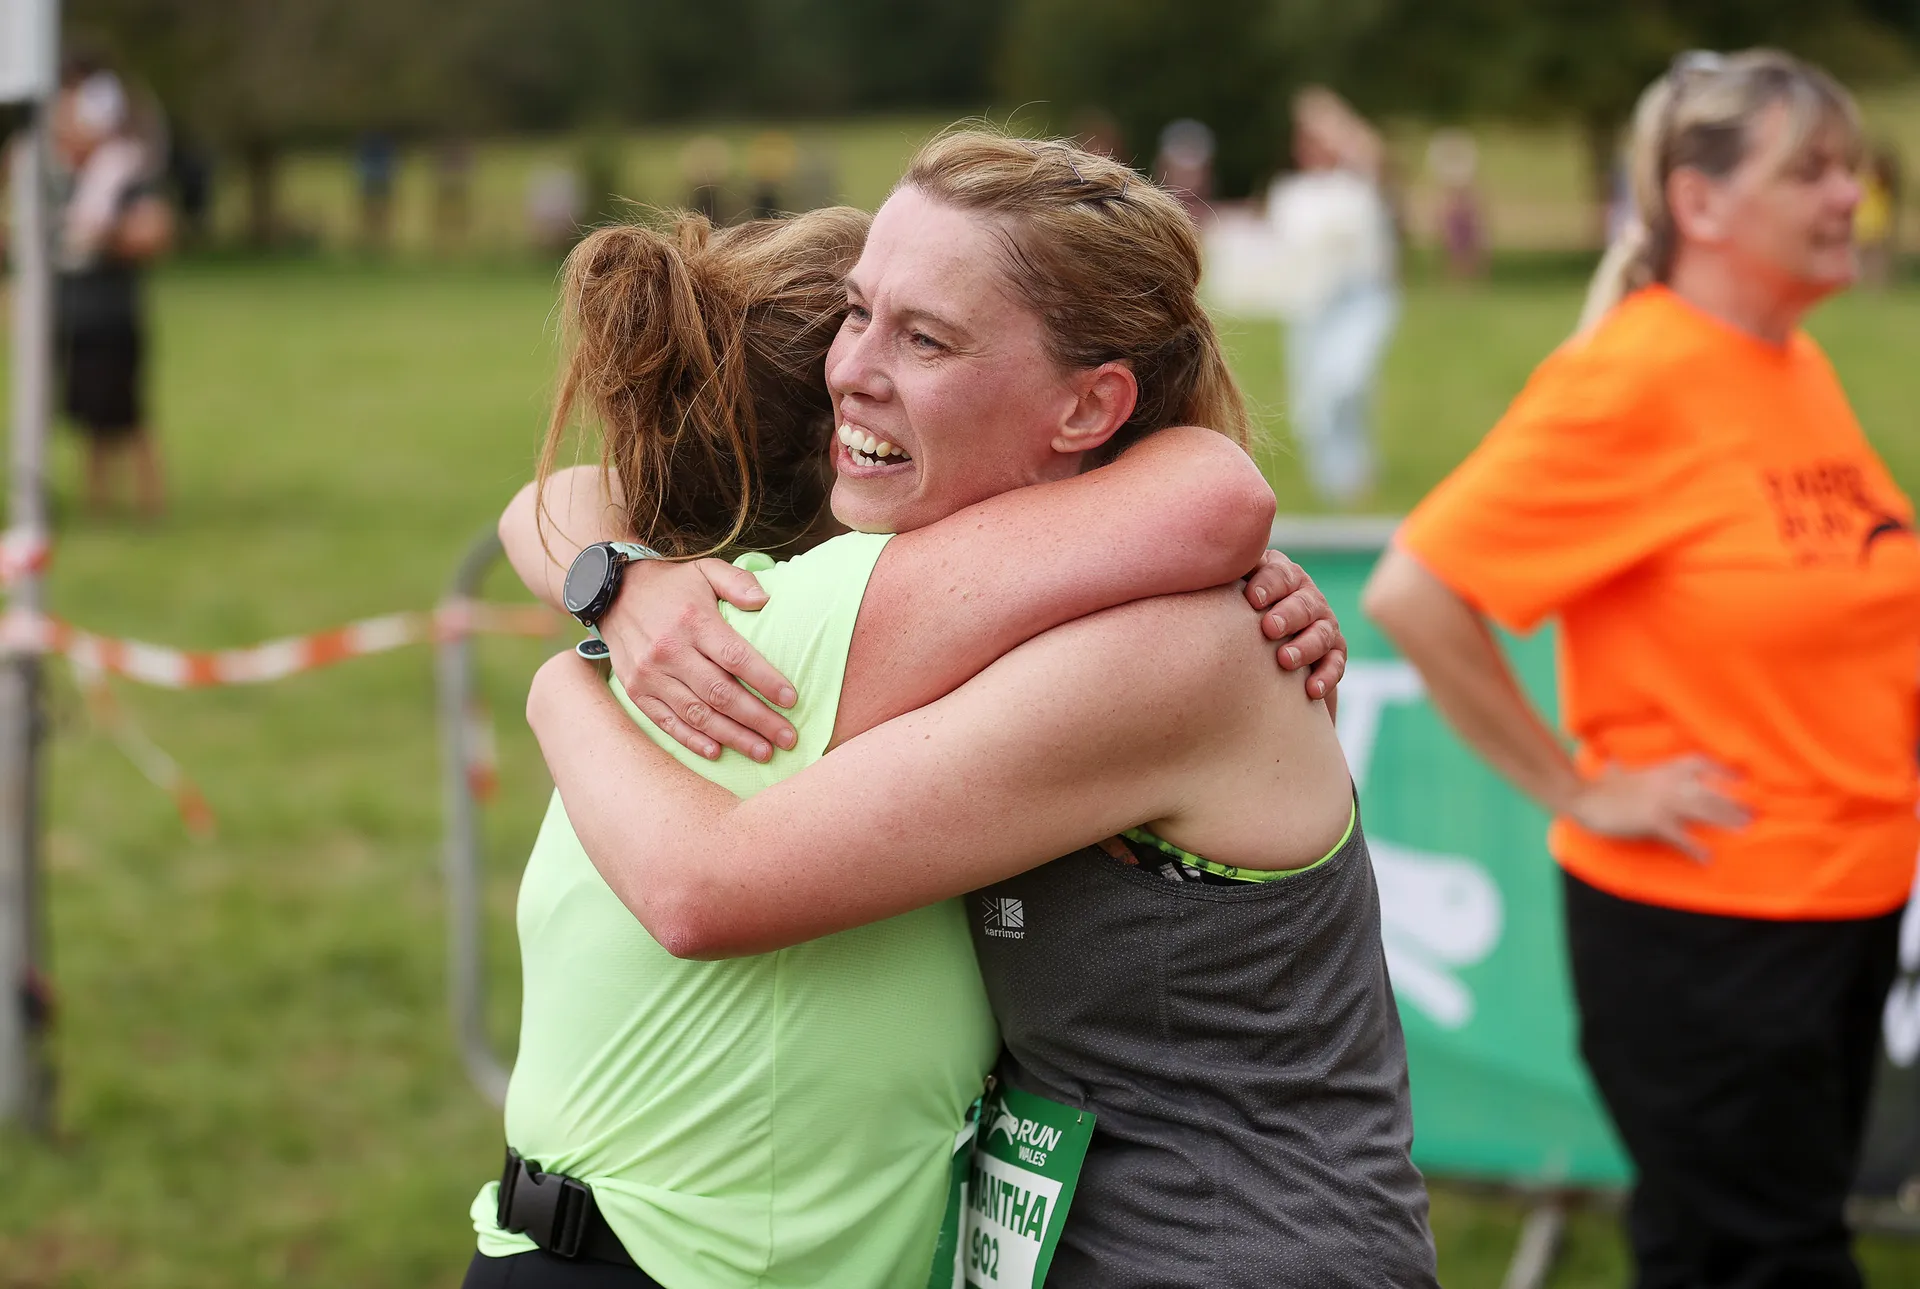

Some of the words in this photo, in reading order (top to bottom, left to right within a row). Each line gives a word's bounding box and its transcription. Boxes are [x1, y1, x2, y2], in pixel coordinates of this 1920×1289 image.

[984, 925, 1026, 939] karrimor
[1016, 1119, 1062, 1151] RUN
[1018, 1145, 1047, 1167] WALES
[971, 1226, 999, 1281] 902
